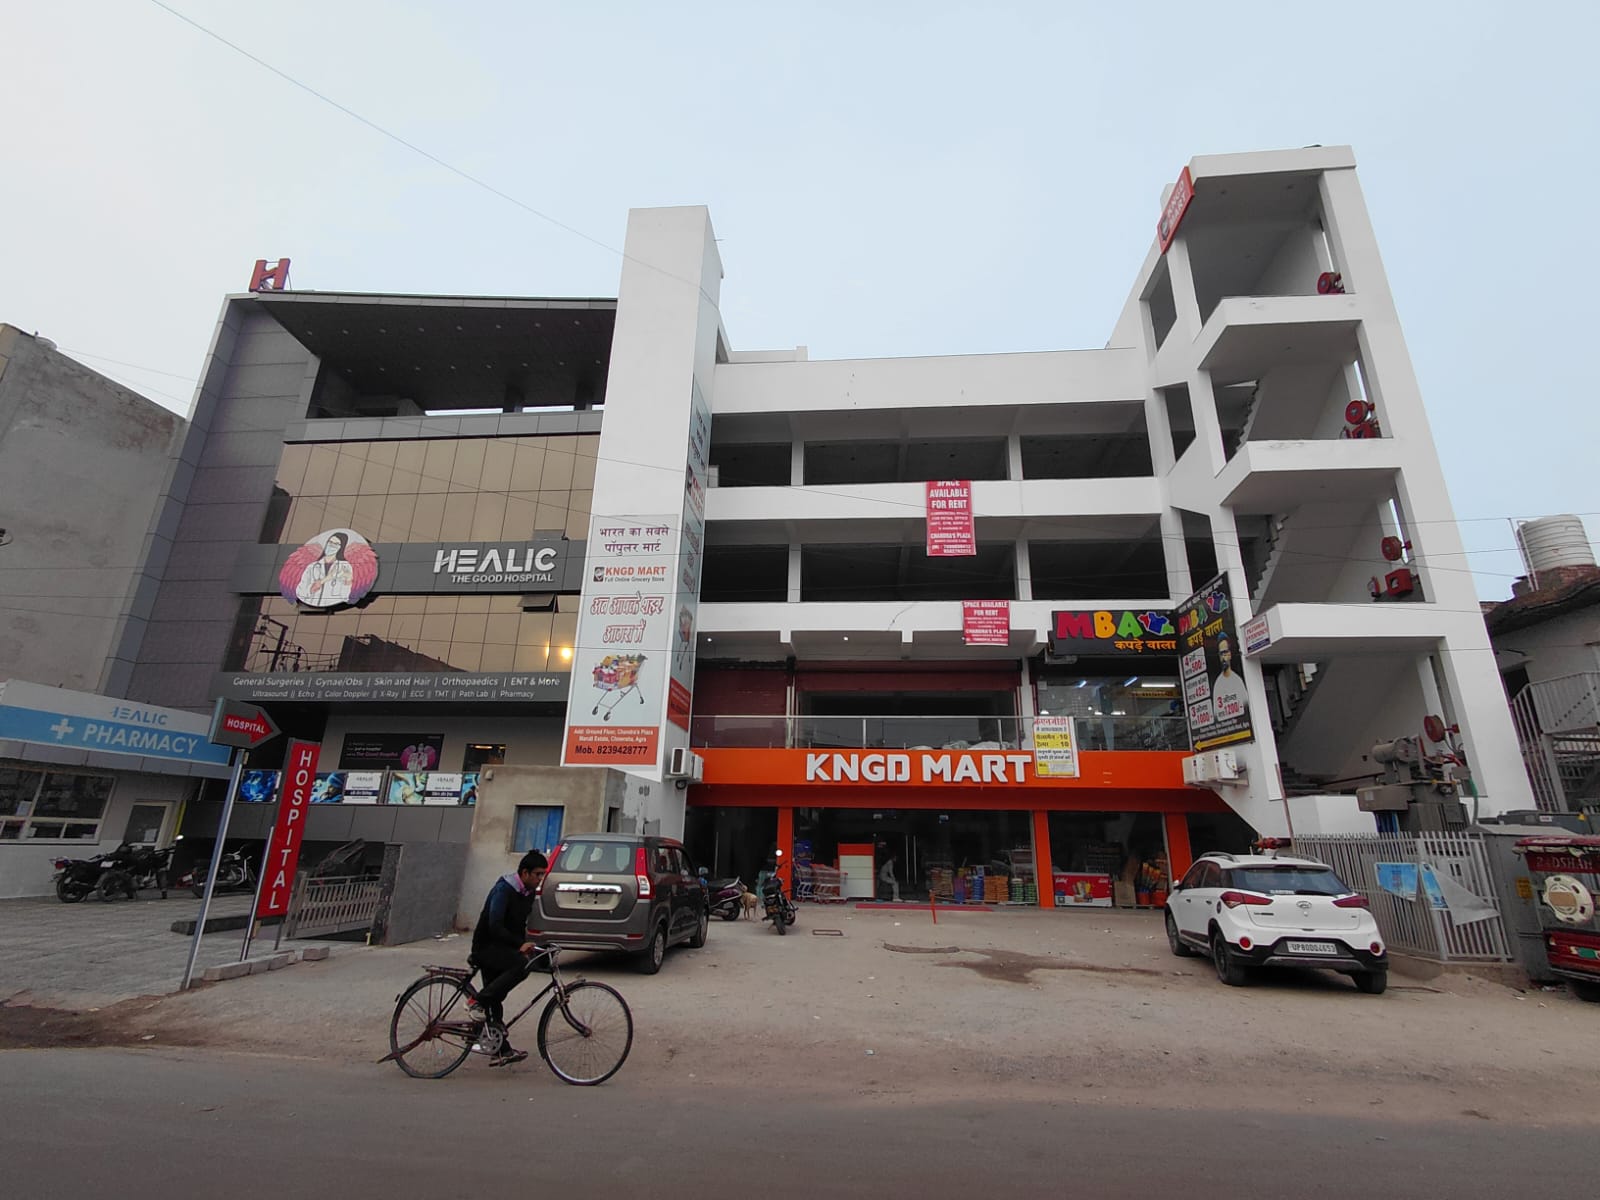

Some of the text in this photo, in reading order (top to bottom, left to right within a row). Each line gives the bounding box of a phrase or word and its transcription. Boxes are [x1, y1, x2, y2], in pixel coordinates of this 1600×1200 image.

[929, 488, 969, 498] AVAILABLE
[931, 499, 967, 509] FOR RENT
[599, 523, 669, 537] भारत का सबसे
[642, 538, 662, 552] मार्ट
[433, 547, 557, 573] HEALIC
[451, 573, 554, 584] THE GOOD HOSPITAL
[605, 566, 667, 577] KNGD MART
[1056, 610, 1144, 639] MBA
[1177, 604, 1208, 636] MBA
[1114, 638, 1177, 653] कपड़े वाला
[233, 676, 561, 688] General Surgeries Gynae/Obs Skin and Hair Orthopaedics ENT & More
[252, 690, 289, 698] Ultrasound
[297, 690, 315, 698] Echo
[324, 690, 342, 698] Color
[343, 690, 370, 699] Doppler
[380, 690, 399, 698] X-Ray
[410, 690, 425, 698] ECG
[476, 690, 489, 698] Lab
[500, 690, 534, 699] Pharmacy
[226, 718, 266, 734] HOSPITAL
[82, 722, 199, 755] PHARMACY
[575, 745, 648, 755] Mob. 8239428777
[806, 753, 1032, 782] KNGD MART
[269, 750, 313, 910] HOSPITAL
